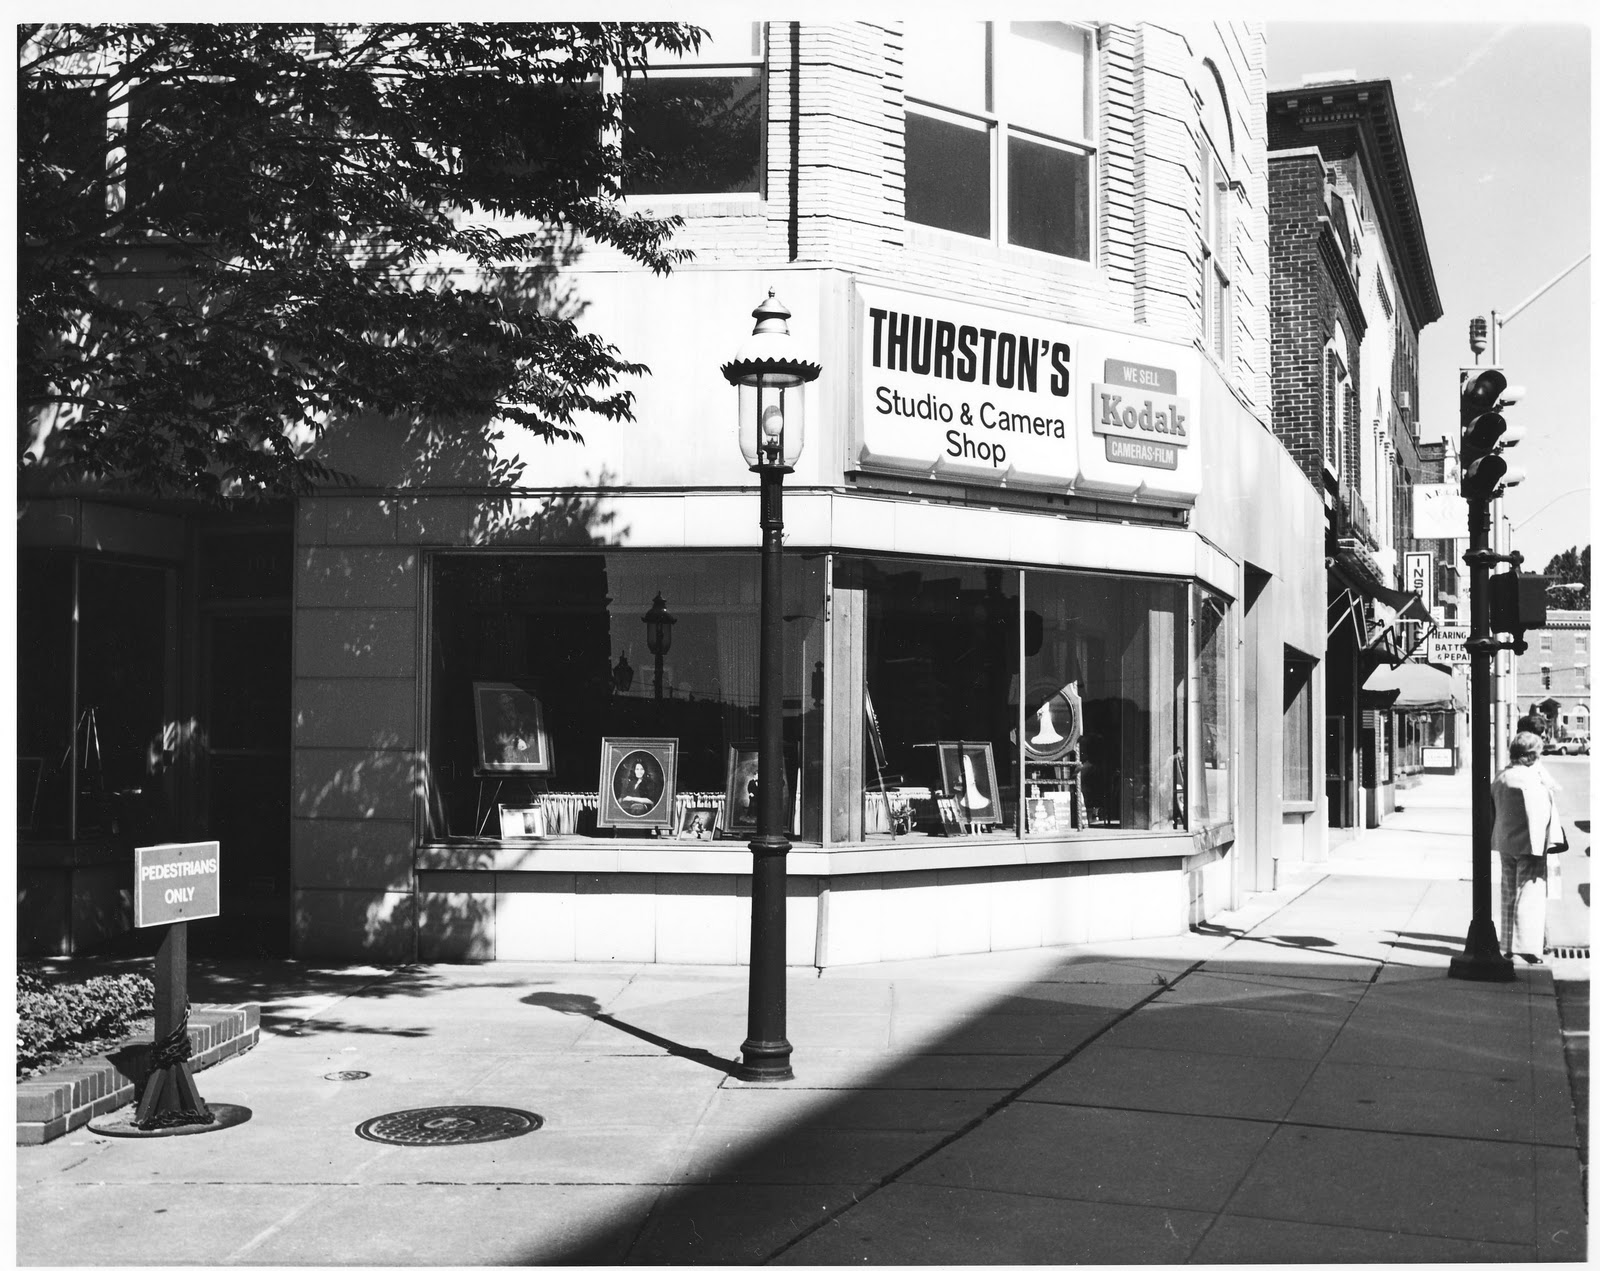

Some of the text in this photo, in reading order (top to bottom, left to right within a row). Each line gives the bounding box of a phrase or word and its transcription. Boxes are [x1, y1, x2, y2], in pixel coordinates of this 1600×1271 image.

[869, 307, 1070, 398] THURSTON'S
[1123, 366, 1161, 387] WE SELL
[875, 386, 1065, 439] Studio & Camera
[1100, 393, 1187, 436] Kodak
[946, 429, 1006, 467] Shop
[1431, 631, 1467, 640] HEARING
[141, 858, 217, 881] PEDESTRIANS
[164, 886, 195, 904] ONLY
